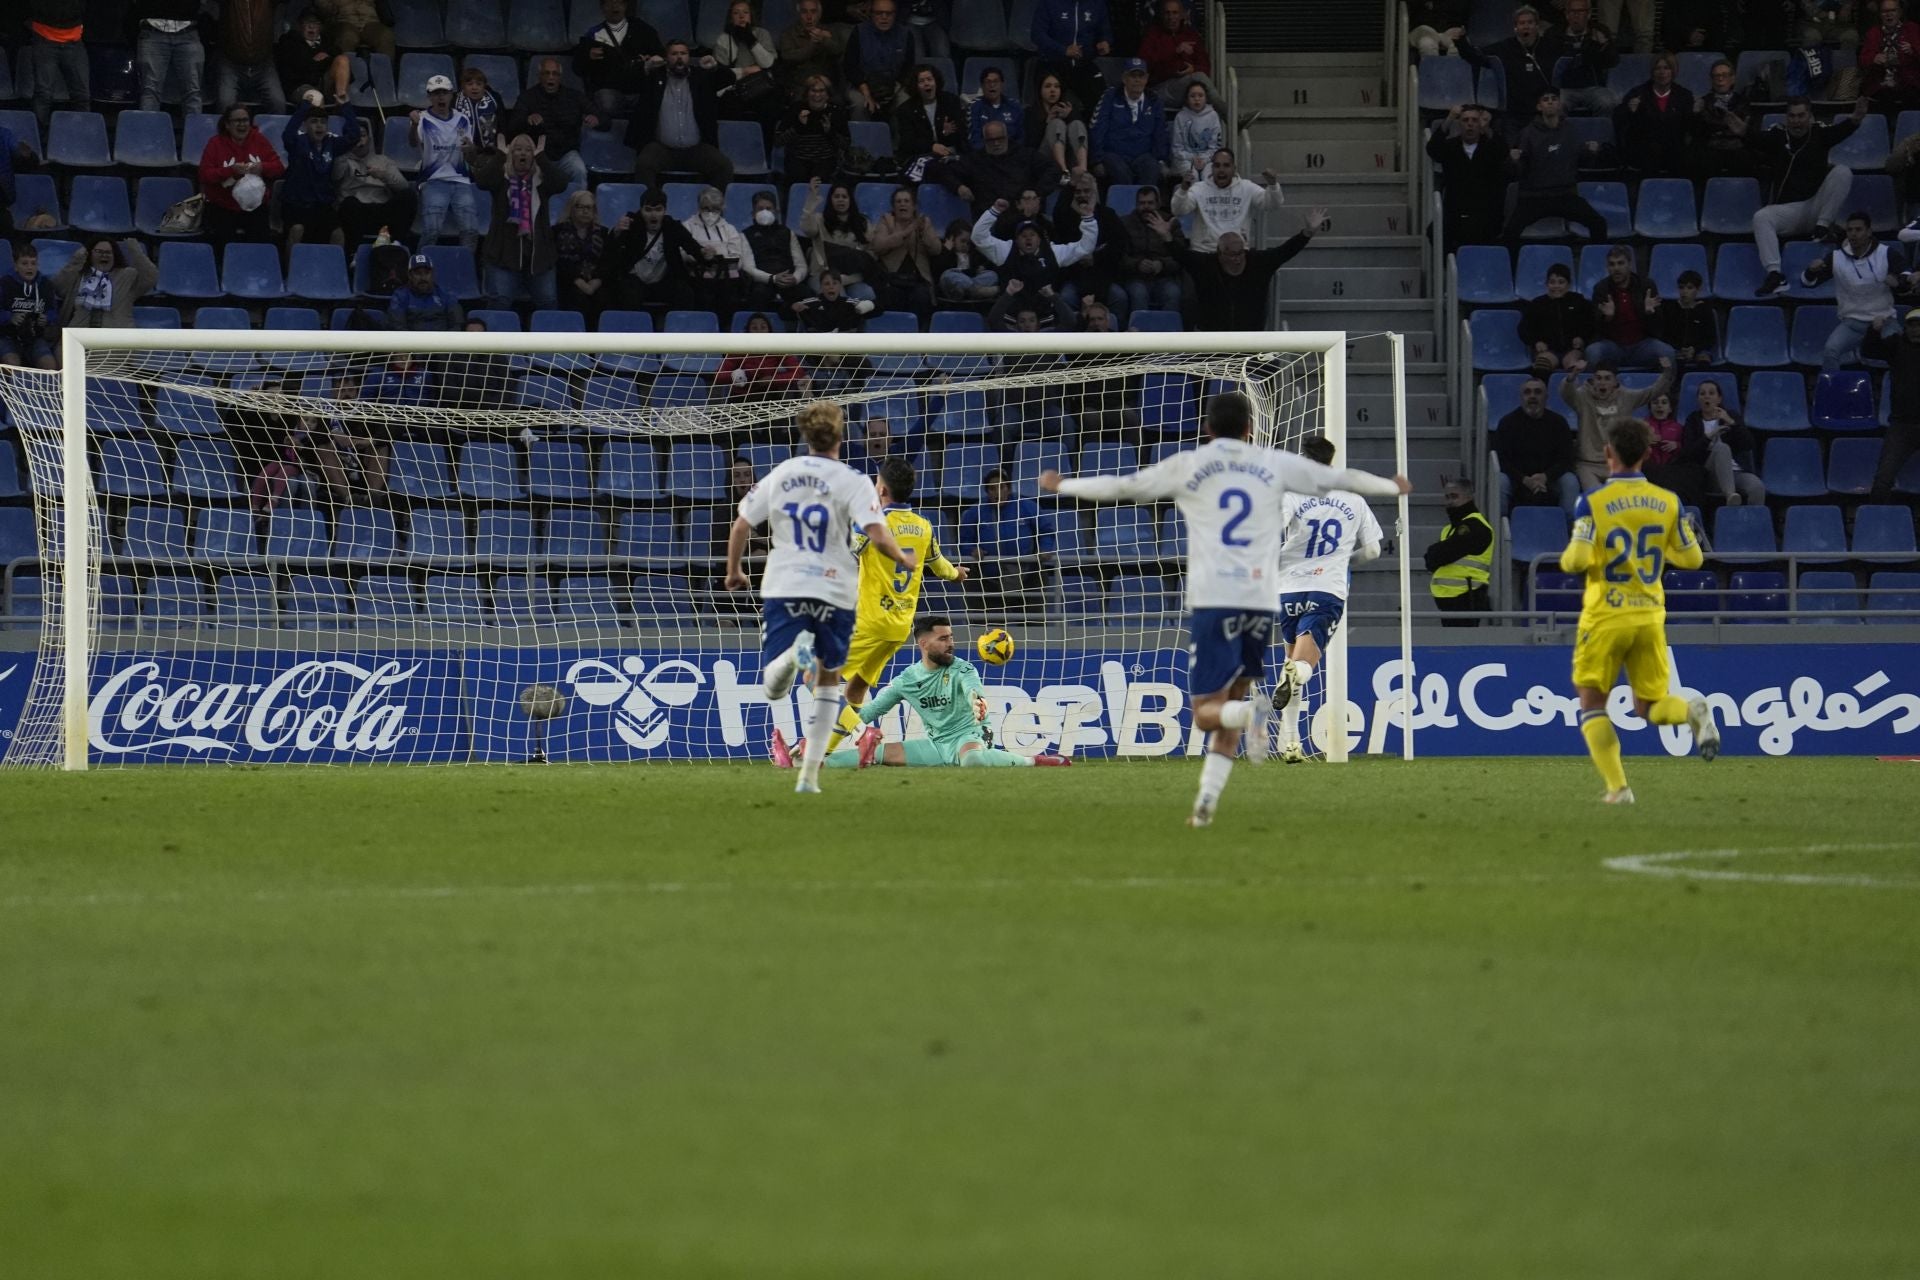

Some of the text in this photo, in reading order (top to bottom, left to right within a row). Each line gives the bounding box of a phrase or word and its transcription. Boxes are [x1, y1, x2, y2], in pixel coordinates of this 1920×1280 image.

[1294, 89, 1373, 104] 11 W
[1306, 153, 1387, 168] 10 W
[1387, 216, 1400, 232] W
[1333, 280, 1413, 296] 8 W
[1412, 344, 1424, 359] W
[1356, 407, 1440, 422] 6 W
[1319, 497, 1355, 521] GALLEGO
[1605, 497, 1667, 516] MELENDO
[1219, 487, 1253, 547] 2
[782, 501, 830, 553] 19
[1304, 518, 1343, 559] 18
[1383, 539, 1395, 555] 4
[1604, 524, 1666, 585] 25
[87, 660, 423, 754] Coca-Cola
